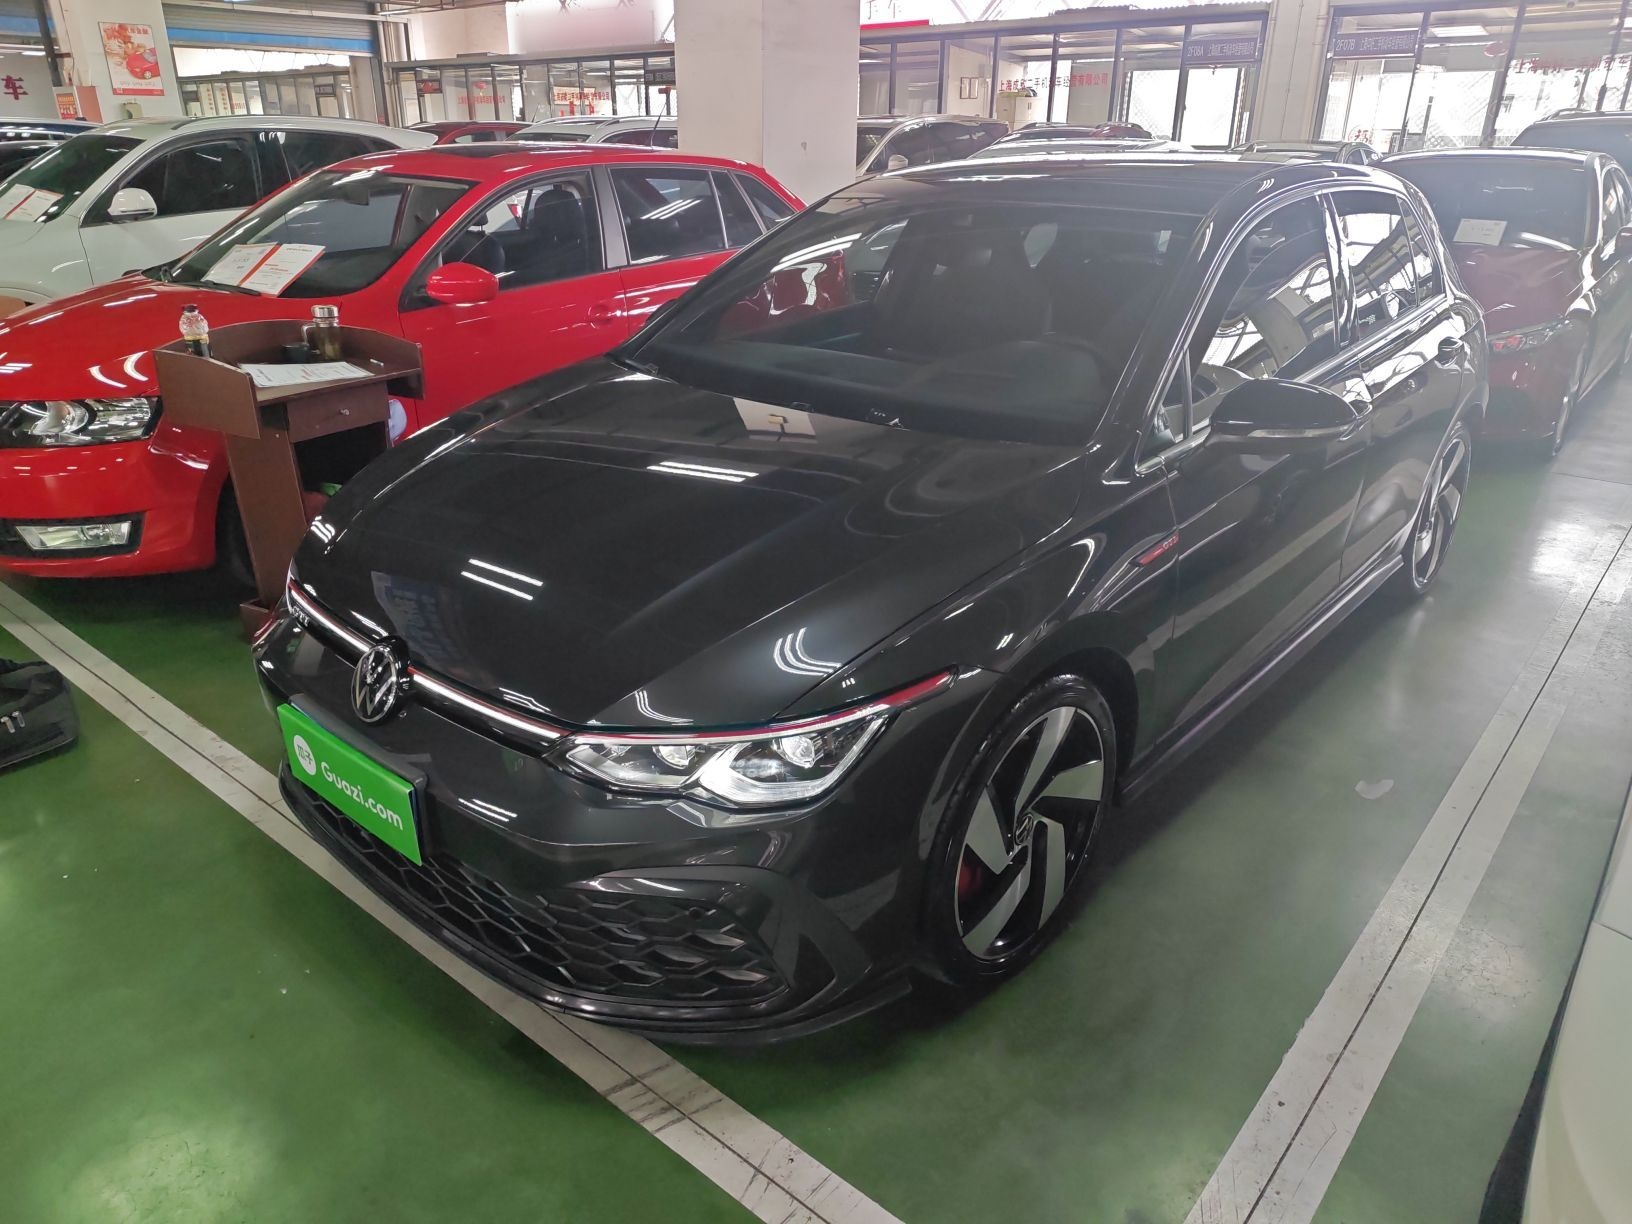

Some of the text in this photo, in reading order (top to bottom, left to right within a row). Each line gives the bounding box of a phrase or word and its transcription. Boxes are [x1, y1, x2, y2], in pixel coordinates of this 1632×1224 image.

[1, 75, 29, 101] 车
[296, 742, 313, 767] 瓜子
[320, 761, 404, 832] Guazi.com
